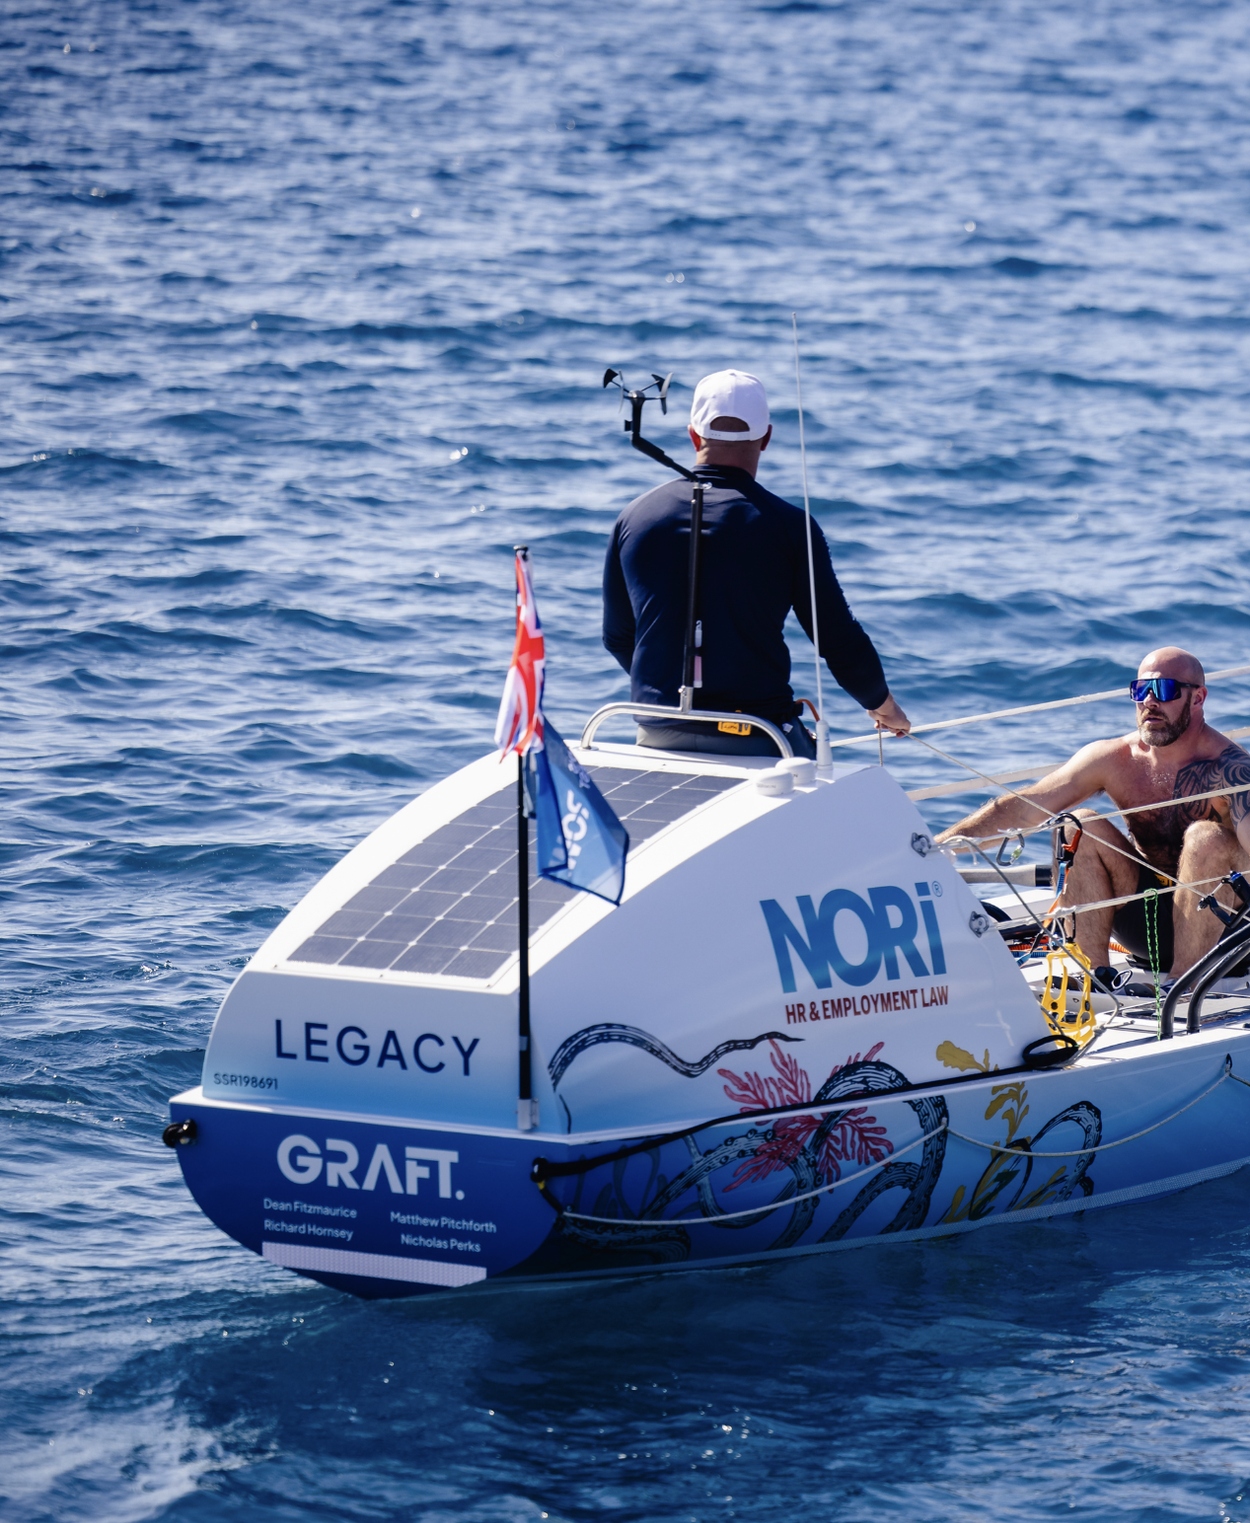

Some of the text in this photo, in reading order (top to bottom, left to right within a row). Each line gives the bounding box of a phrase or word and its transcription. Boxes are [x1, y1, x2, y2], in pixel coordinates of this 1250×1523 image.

[785, 985, 949, 1025] HR & EMPLOYMENT LAW
[275, 1019, 480, 1076] LEGACY
[213, 1073, 278, 1091] SSR198691
[277, 1134, 465, 1200] GRAFT.
[263, 1197, 358, 1219] Dean Fitzmaurice
[264, 1219, 354, 1241] Richard Hornsey
[390, 1210, 497, 1233] Matthew Pitchforth
[401, 1233, 481, 1253] Nicholas Perks
